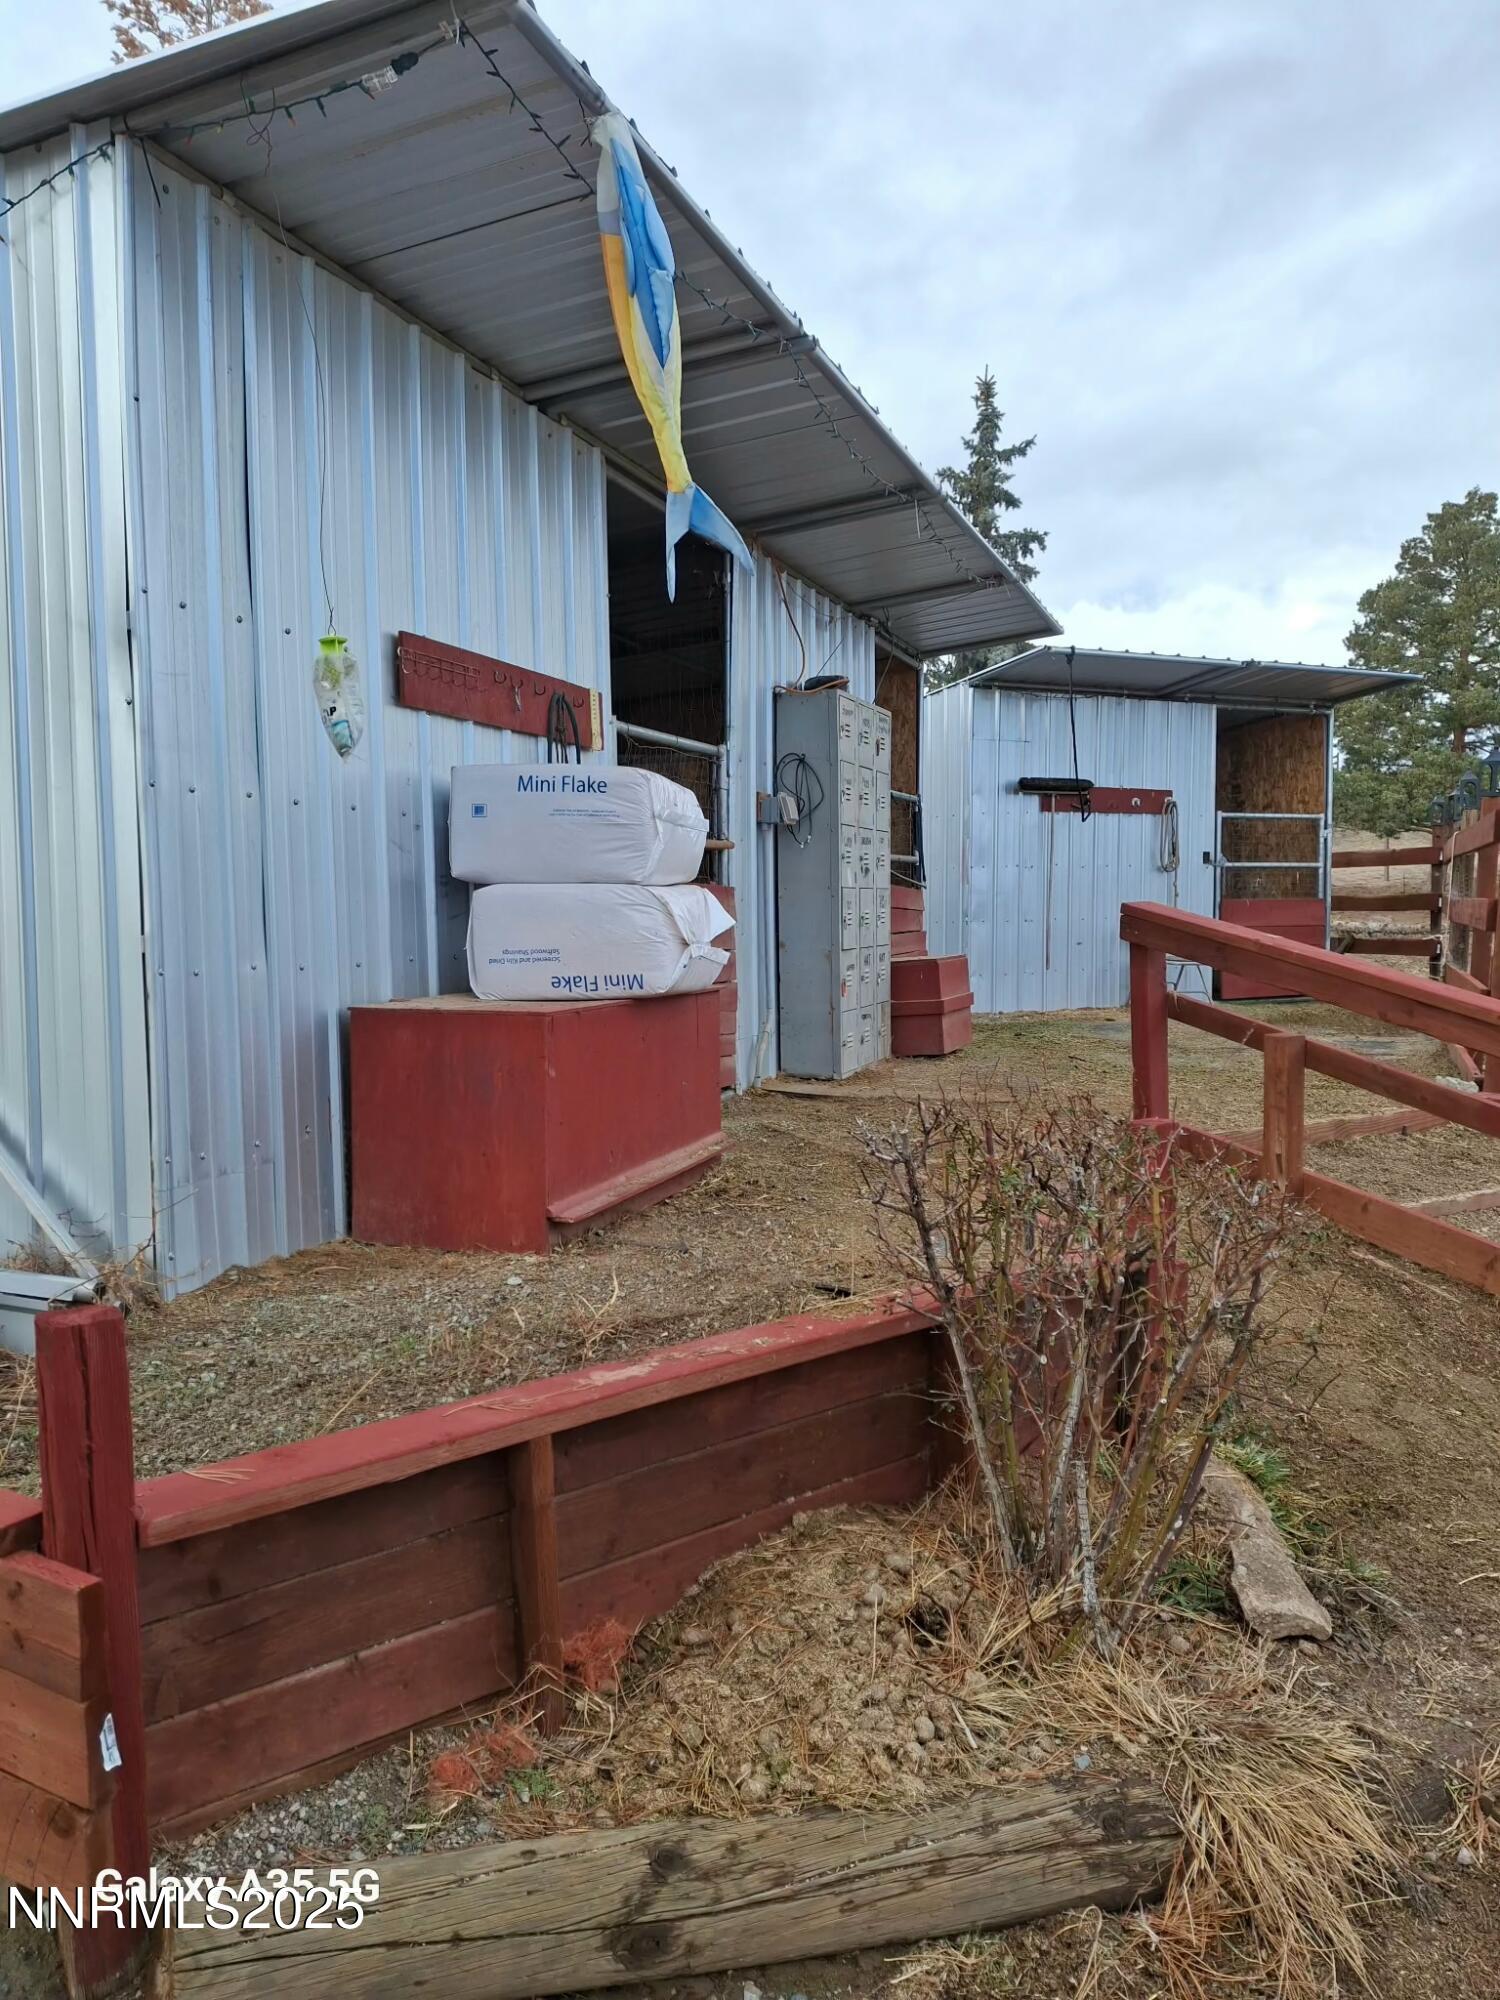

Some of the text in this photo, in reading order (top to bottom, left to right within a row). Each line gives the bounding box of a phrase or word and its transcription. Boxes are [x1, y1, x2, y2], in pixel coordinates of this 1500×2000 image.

[517, 775, 608, 794] Mini Flake
[530, 948, 560, 956] Softwood
[551, 973, 644, 992] Mini Flake
